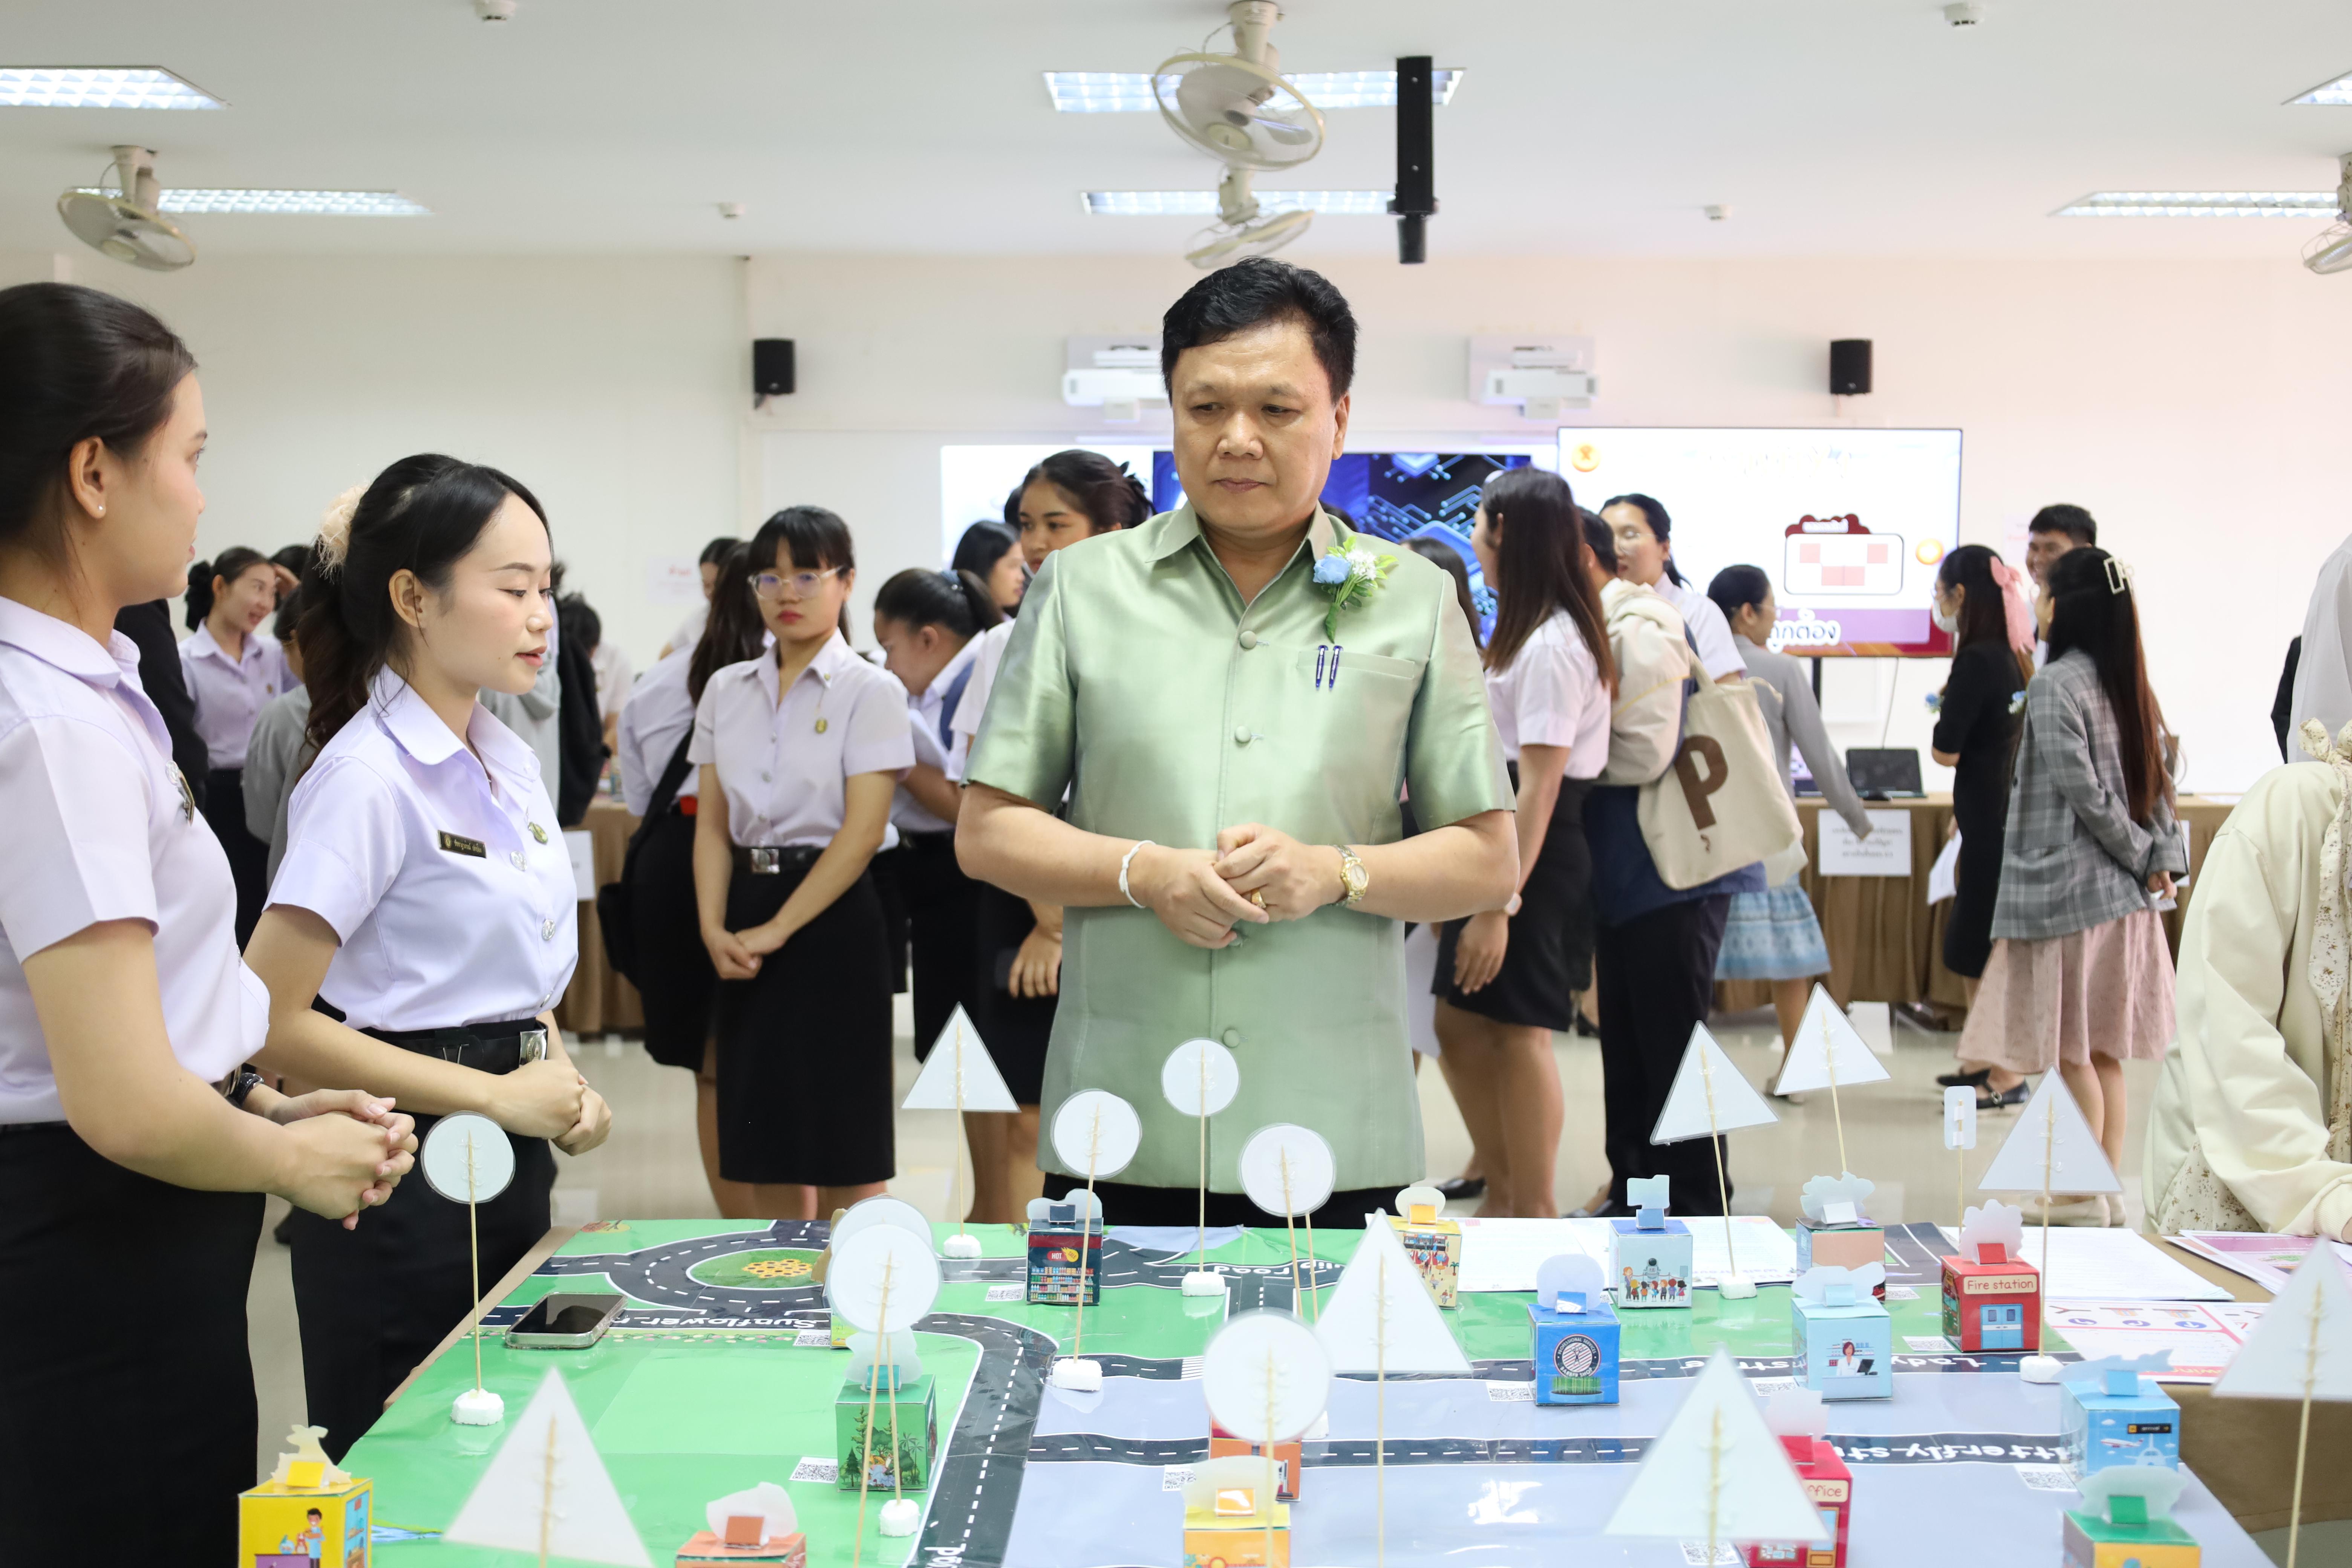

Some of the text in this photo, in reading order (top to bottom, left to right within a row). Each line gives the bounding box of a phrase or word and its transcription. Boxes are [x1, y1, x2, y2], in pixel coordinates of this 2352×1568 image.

[1674, 735, 1728, 830] P
[1068, 1251, 1077, 1259] SALE
[1214, 1260, 1340, 1274] lip road
[1968, 1279, 2034, 1290] Fire station
[642, 1317, 816, 1329] Sunflower
[1557, 1337, 1597, 1354] PROFESSIONAL SERVICES
[1891, 1356, 1979, 1367] Lady
[1560, 1366, 1592, 1377] BARBER SHOP
[1906, 1443, 2060, 1460] tterfly
[1807, 1484, 1842, 1497] ffice
[924, 1547, 962, 1568] oad
